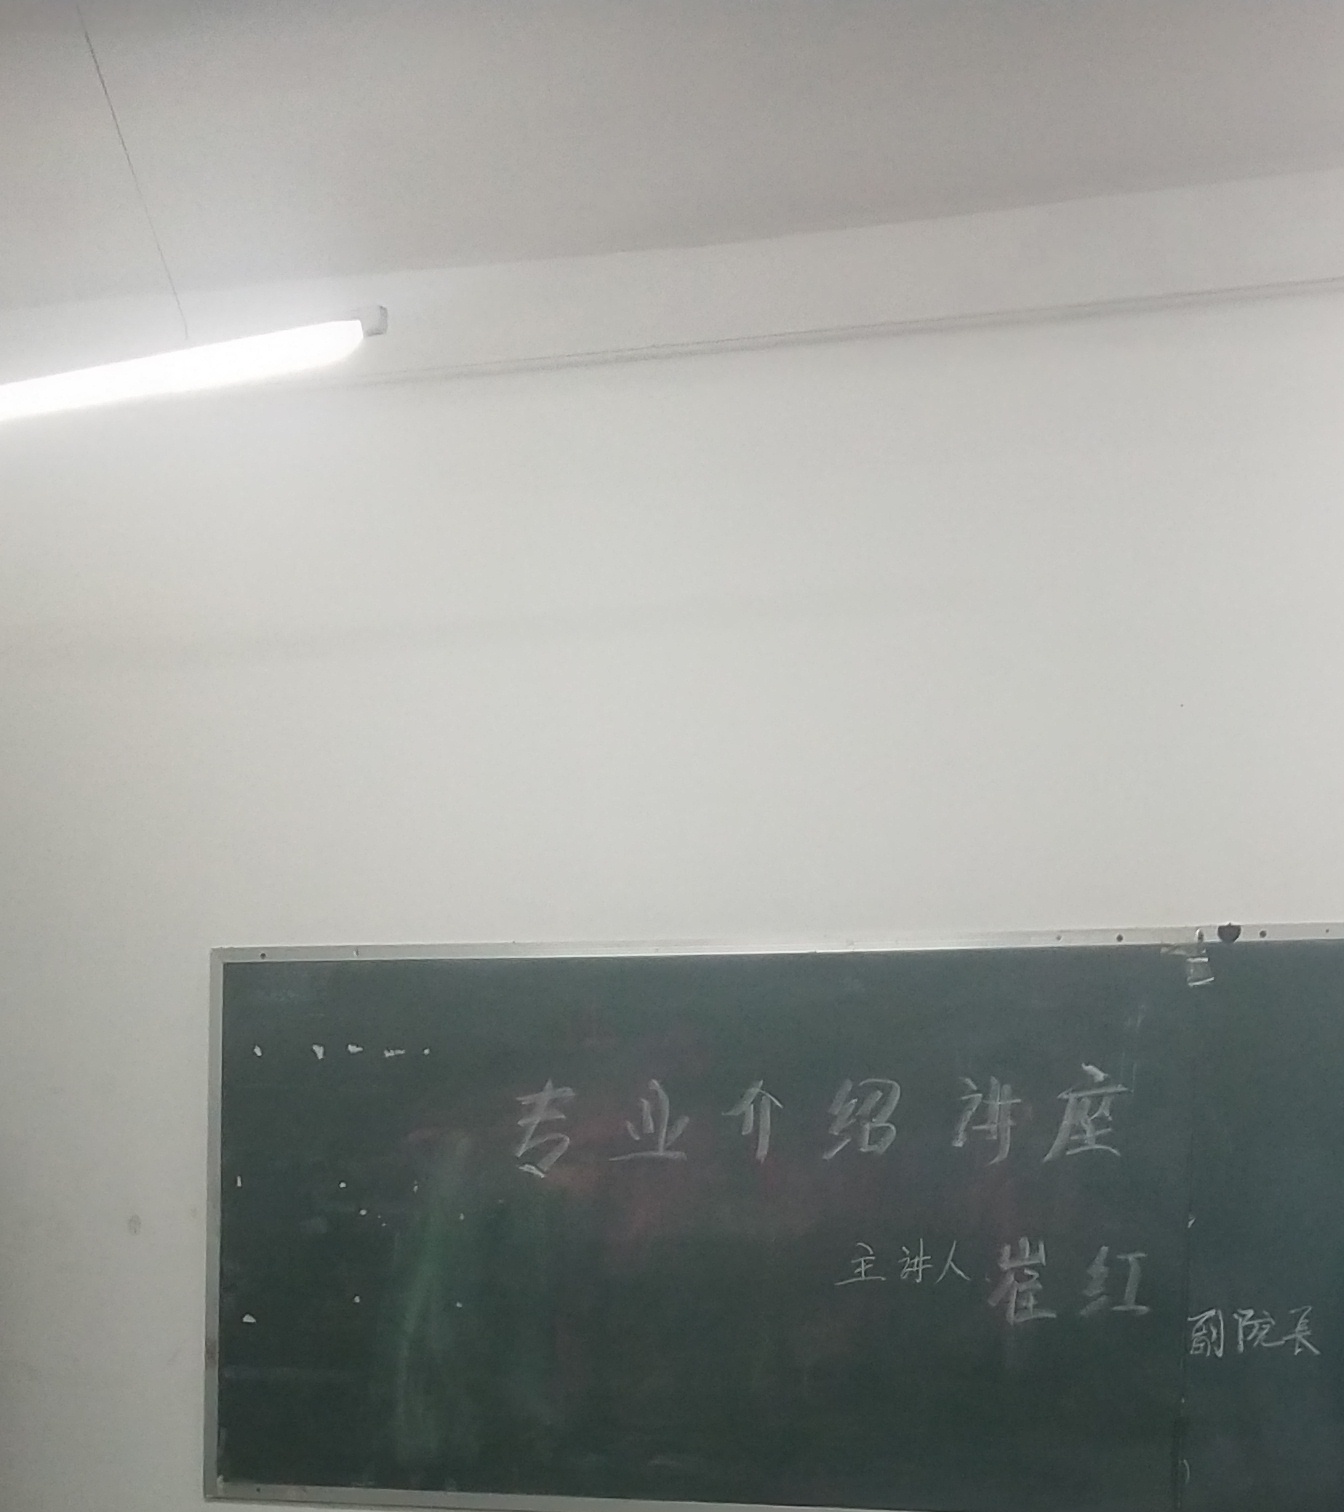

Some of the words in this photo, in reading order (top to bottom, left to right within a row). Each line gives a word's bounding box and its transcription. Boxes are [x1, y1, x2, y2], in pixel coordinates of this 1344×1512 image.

[516, 1062, 1132, 1178] 专业介绍讲座
[834, 1239, 971, 1286] 主讲人
[987, 1236, 1150, 1326] 崔红
